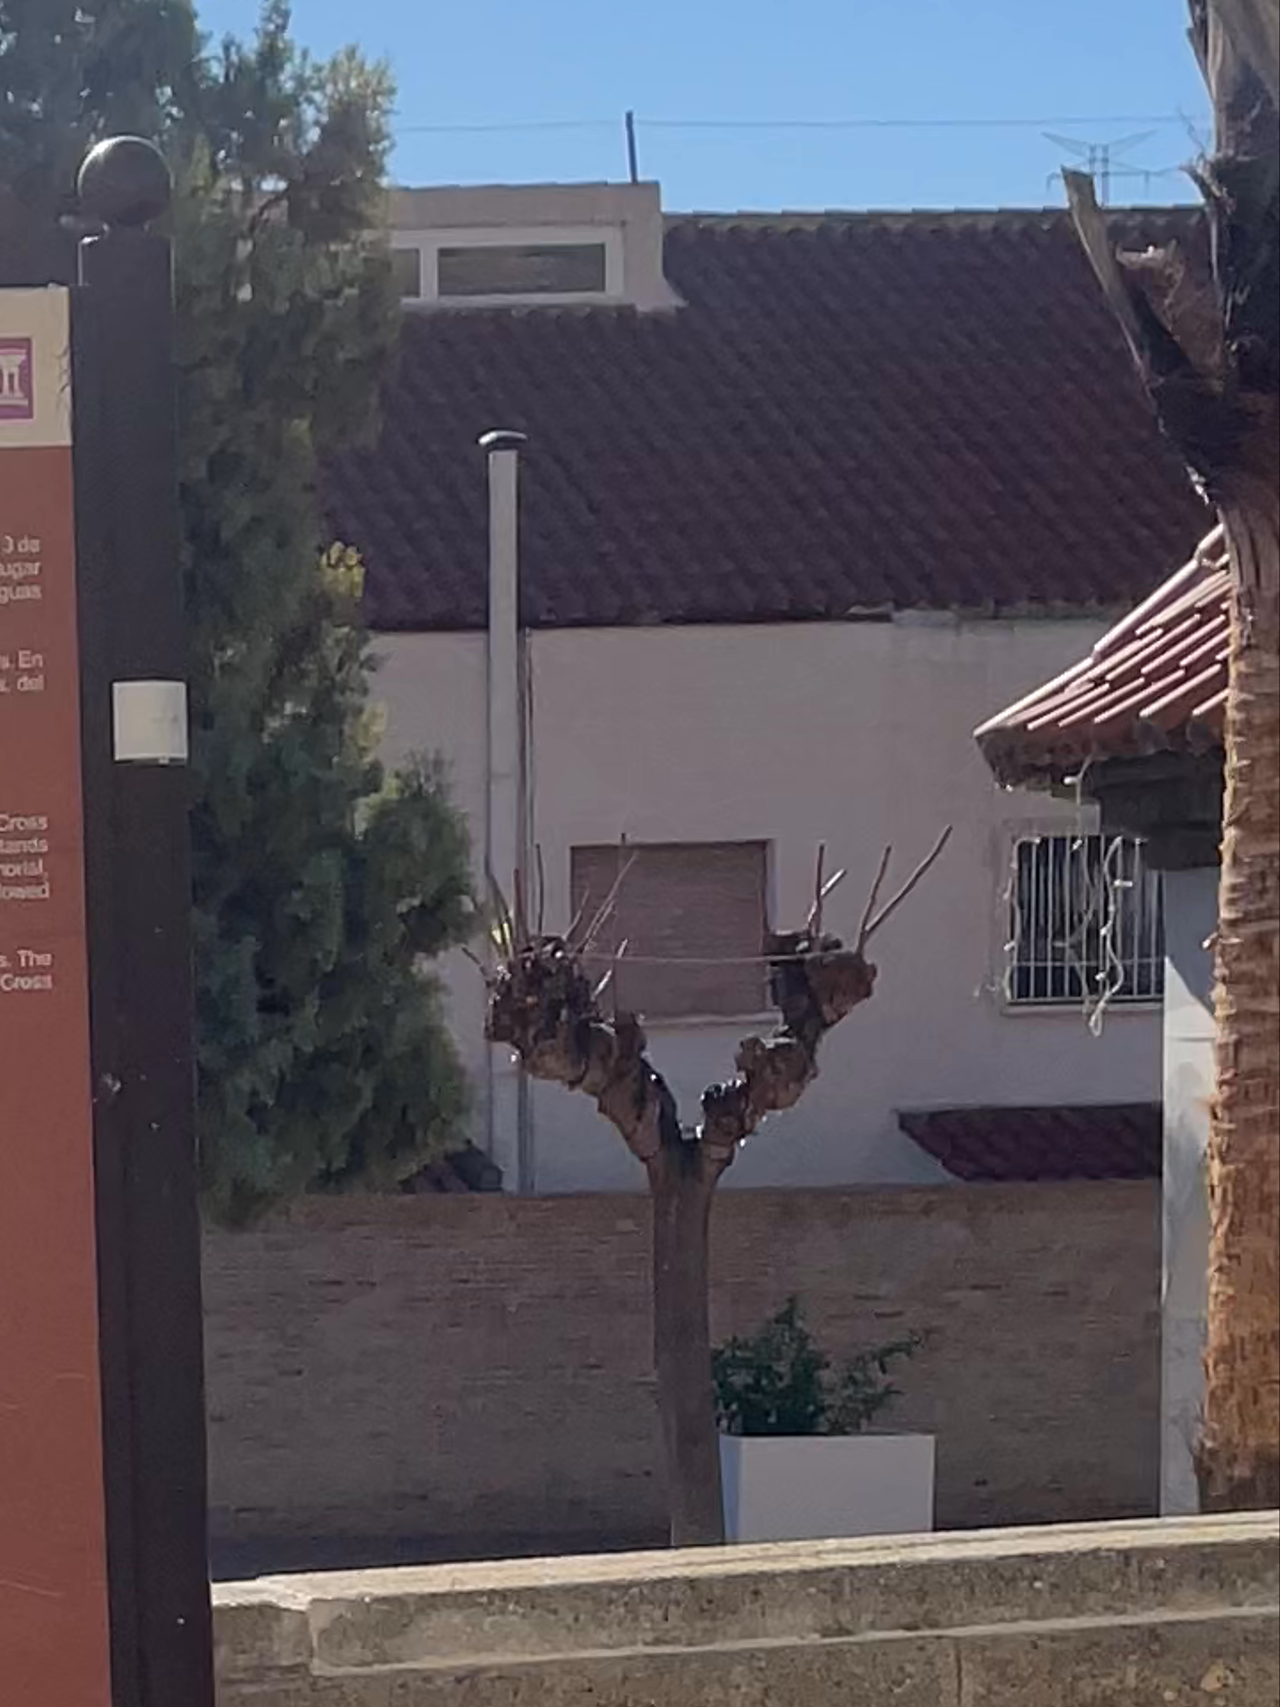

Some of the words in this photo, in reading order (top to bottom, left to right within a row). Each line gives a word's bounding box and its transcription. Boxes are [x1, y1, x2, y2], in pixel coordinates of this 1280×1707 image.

[17, 535, 39, 552] de
[19, 651, 42, 668] En
[17, 950, 51, 967] The
